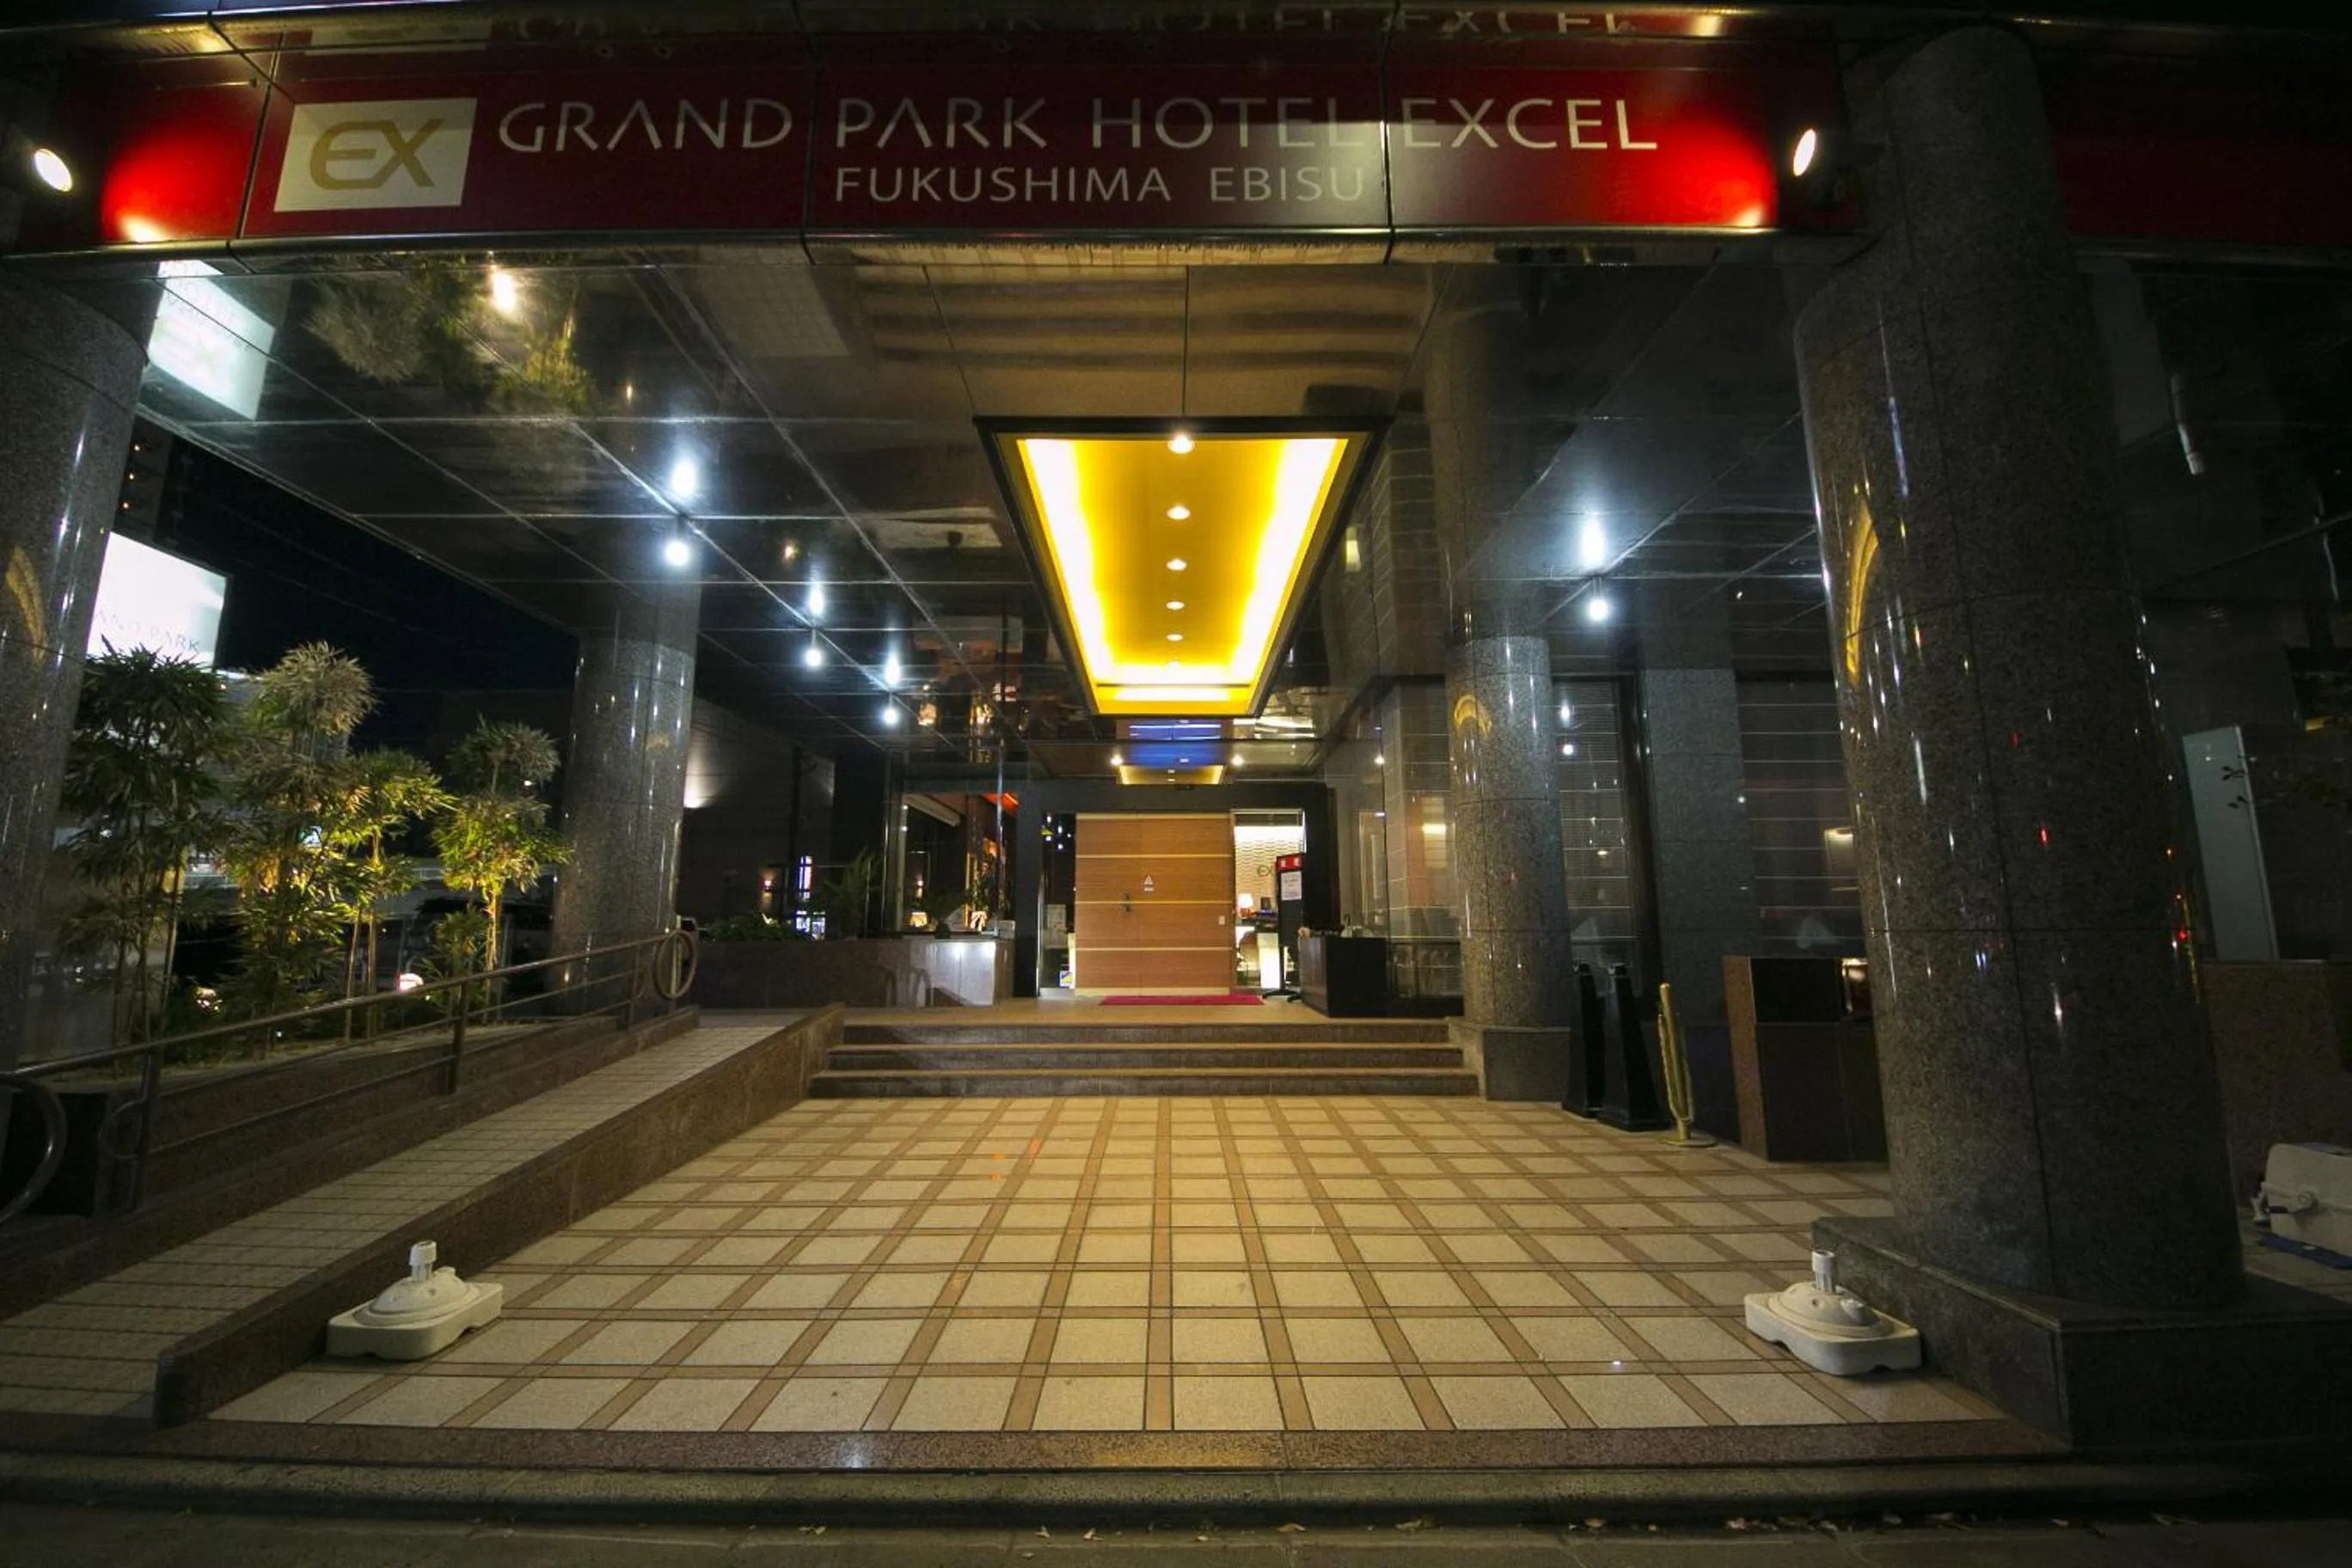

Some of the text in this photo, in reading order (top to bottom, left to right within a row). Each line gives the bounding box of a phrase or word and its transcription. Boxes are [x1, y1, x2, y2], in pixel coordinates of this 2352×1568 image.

[499, 96, 1657, 152] GRAND PARK HOTEL EXCEL
[309, 118, 445, 191] EX
[835, 167, 1363, 202] FUKUSHIMA EBISU
